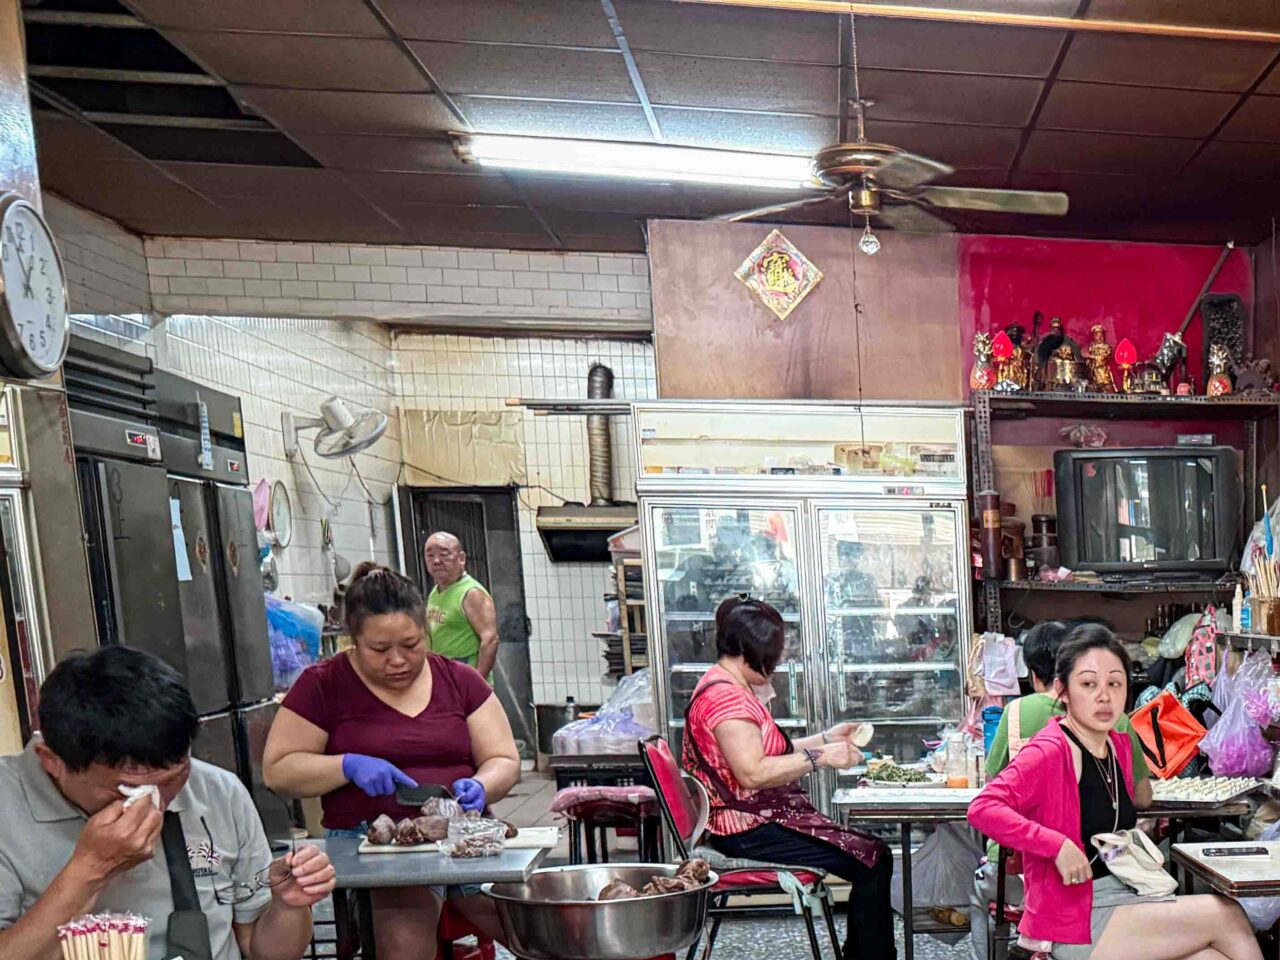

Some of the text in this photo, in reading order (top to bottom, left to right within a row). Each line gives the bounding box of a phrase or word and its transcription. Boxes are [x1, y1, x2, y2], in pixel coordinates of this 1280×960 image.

[39, 257, 48, 276] 2
[46, 286, 55, 304] 3
[29, 333, 36, 351] 6
[40, 330, 46, 348] 5
